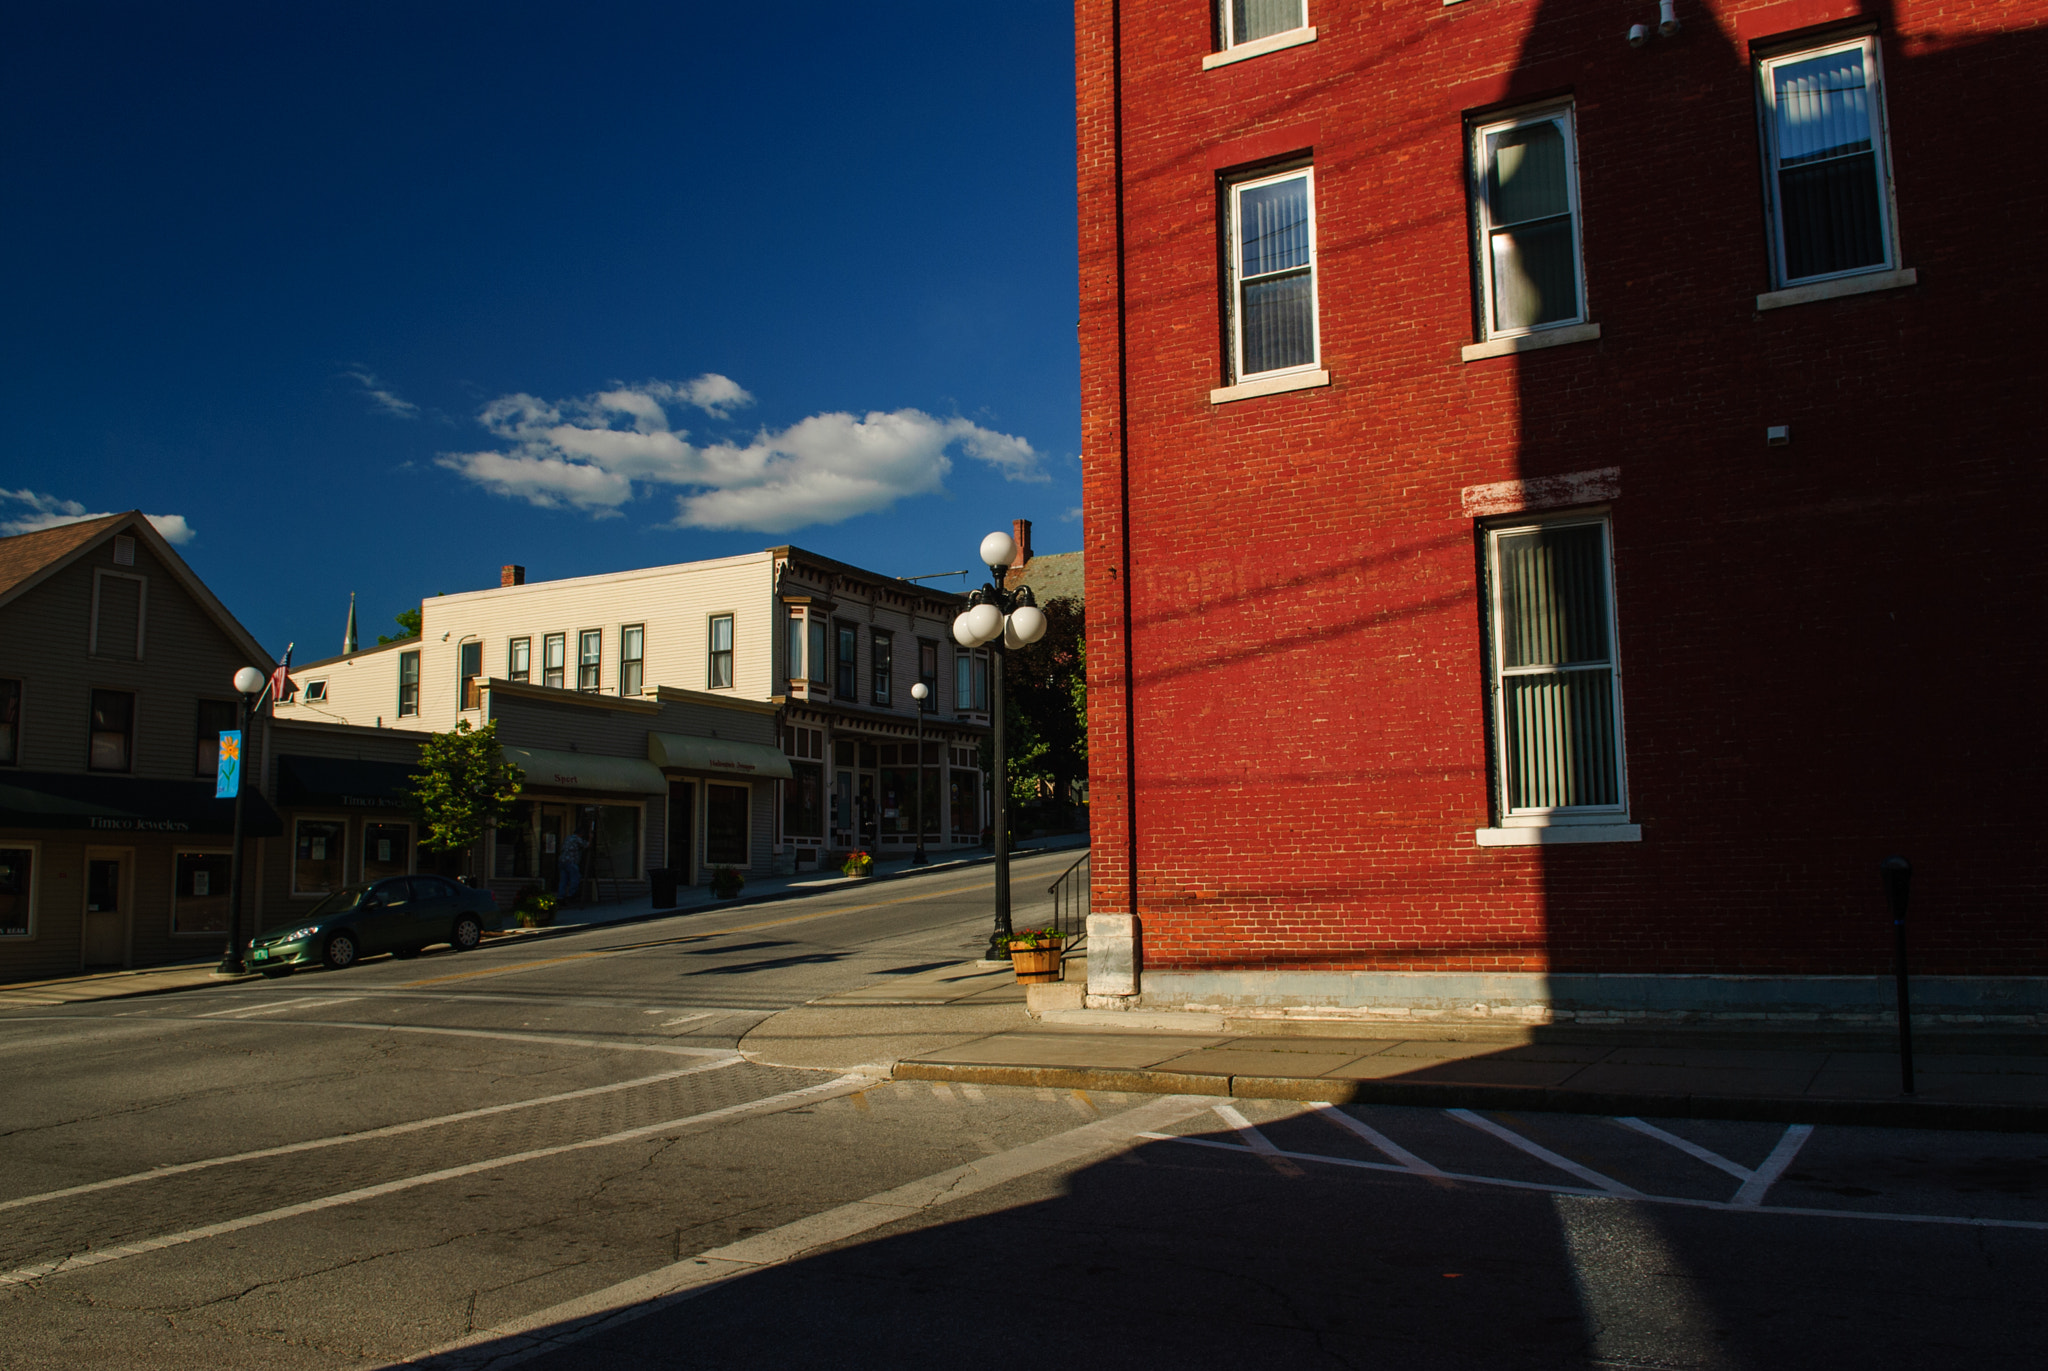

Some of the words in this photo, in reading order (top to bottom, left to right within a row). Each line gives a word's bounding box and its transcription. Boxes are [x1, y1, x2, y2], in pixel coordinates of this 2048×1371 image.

[341, 794, 375, 807] Timco
[88, 816, 133, 830] Timco
[135, 818, 191, 833] Jewelers
